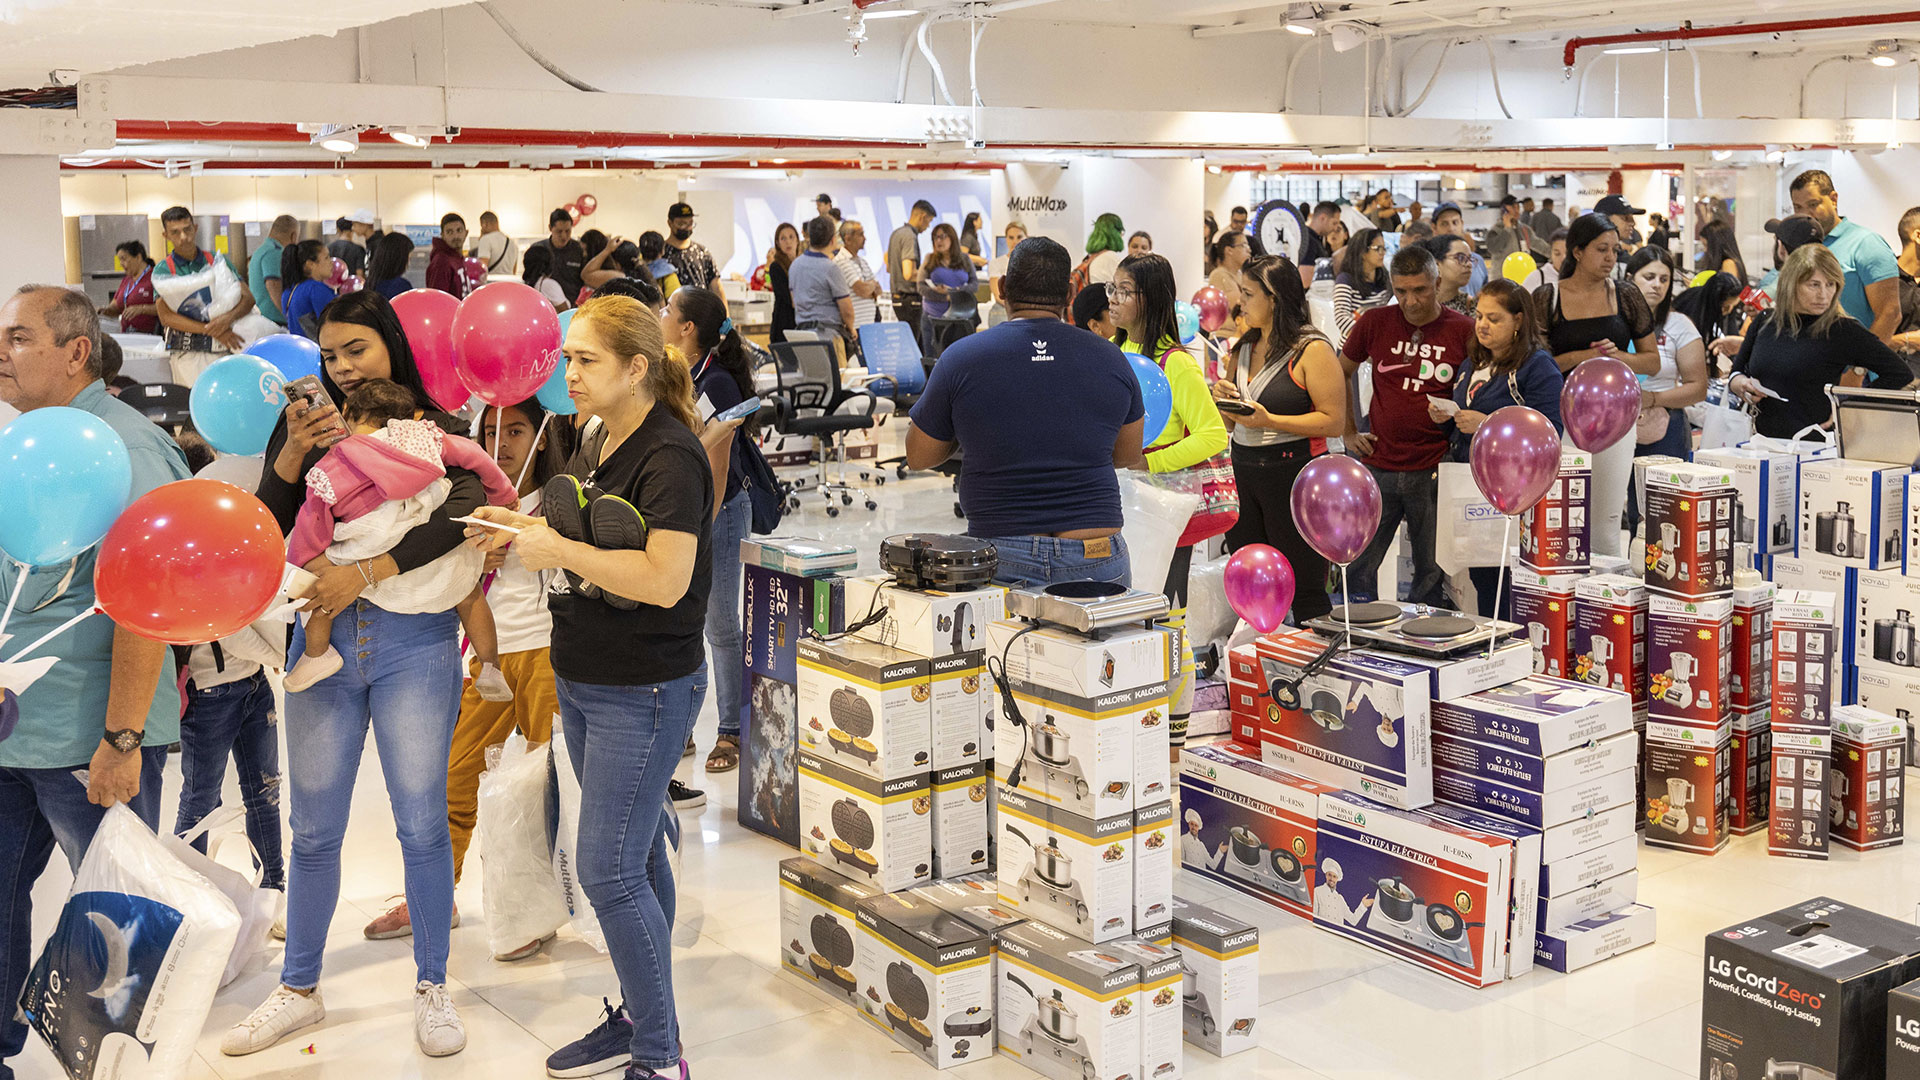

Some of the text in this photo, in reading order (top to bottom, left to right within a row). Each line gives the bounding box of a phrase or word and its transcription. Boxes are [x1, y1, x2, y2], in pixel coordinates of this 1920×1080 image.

[1008, 196, 1066, 211] MultiMax
[1031, 354, 1054, 362] adidas
[1391, 341, 1446, 360] JUST
[1418, 359, 1454, 384] DO
[1402, 377, 1424, 392] IT
[1735, 463, 1757, 471] JUICER
[1804, 472, 1868, 483] ROYAL JUICER
[1776, 565, 1842, 577] ROYAL JUICER
[1861, 578, 1887, 587] ROYAL
[776, 577, 789, 617] 32"
[746, 577, 755, 653] CYBERLUX
[769, 599, 776, 616] HD
[769, 616, 776, 632] TV
[767, 634, 775, 671] SMART
[799, 647, 820, 661] KALORIK
[935, 658, 967, 670] KALORIK
[884, 665, 917, 680] KALORIK
[1861, 676, 1920, 690] ROYAL JUIC
[1135, 683, 1167, 699] KALORIK
[1097, 693, 1132, 707] KALORIK
[1651, 725, 1679, 733] UNIVERSAL
[1509, 733, 1530, 745] ESTUFA
[800, 756, 822, 771] KALORIK
[1185, 758, 1208, 771] UNIVERSAL
[1296, 743, 1365, 773] ESTUFA ELÉCTRICA
[942, 767, 974, 781] KALORIK
[1511, 769, 1532, 782] ESTUFA
[884, 778, 918, 793] KALORIK
[1000, 792, 1027, 809] KALORIK
[1212, 786, 1278, 816] ESTUFA ELÉCTRICA
[1139, 806, 1172, 821] KALORIK
[1325, 802, 1354, 817] UNIVERSAL
[1336, 811, 1354, 822] ROYAL
[1508, 803, 1530, 817] ESTUFA
[1097, 818, 1131, 833] KALORIK
[1360, 833, 1439, 868] ESTUFA ELÉCTRICA
[1443, 844, 1474, 861] IU-E02SS
[560, 851, 575, 911] MultiMax
[781, 868, 802, 884] KALORIK
[858, 909, 878, 928] KALORIK
[1136, 925, 1170, 940] KALORIK
[1737, 926, 1759, 936] LG
[1224, 931, 1258, 948] KALORIK
[940, 947, 977, 962] KALORIK
[1001, 939, 1030, 958] KALORIK
[1146, 960, 1181, 978] KALORIK
[1709, 955, 1731, 978] LG
[1104, 970, 1140, 989] KALORIK
[1709, 976, 1822, 1028] Powerful, Cordless, Long-Lasting
[1896, 1014, 1920, 1038] LG
